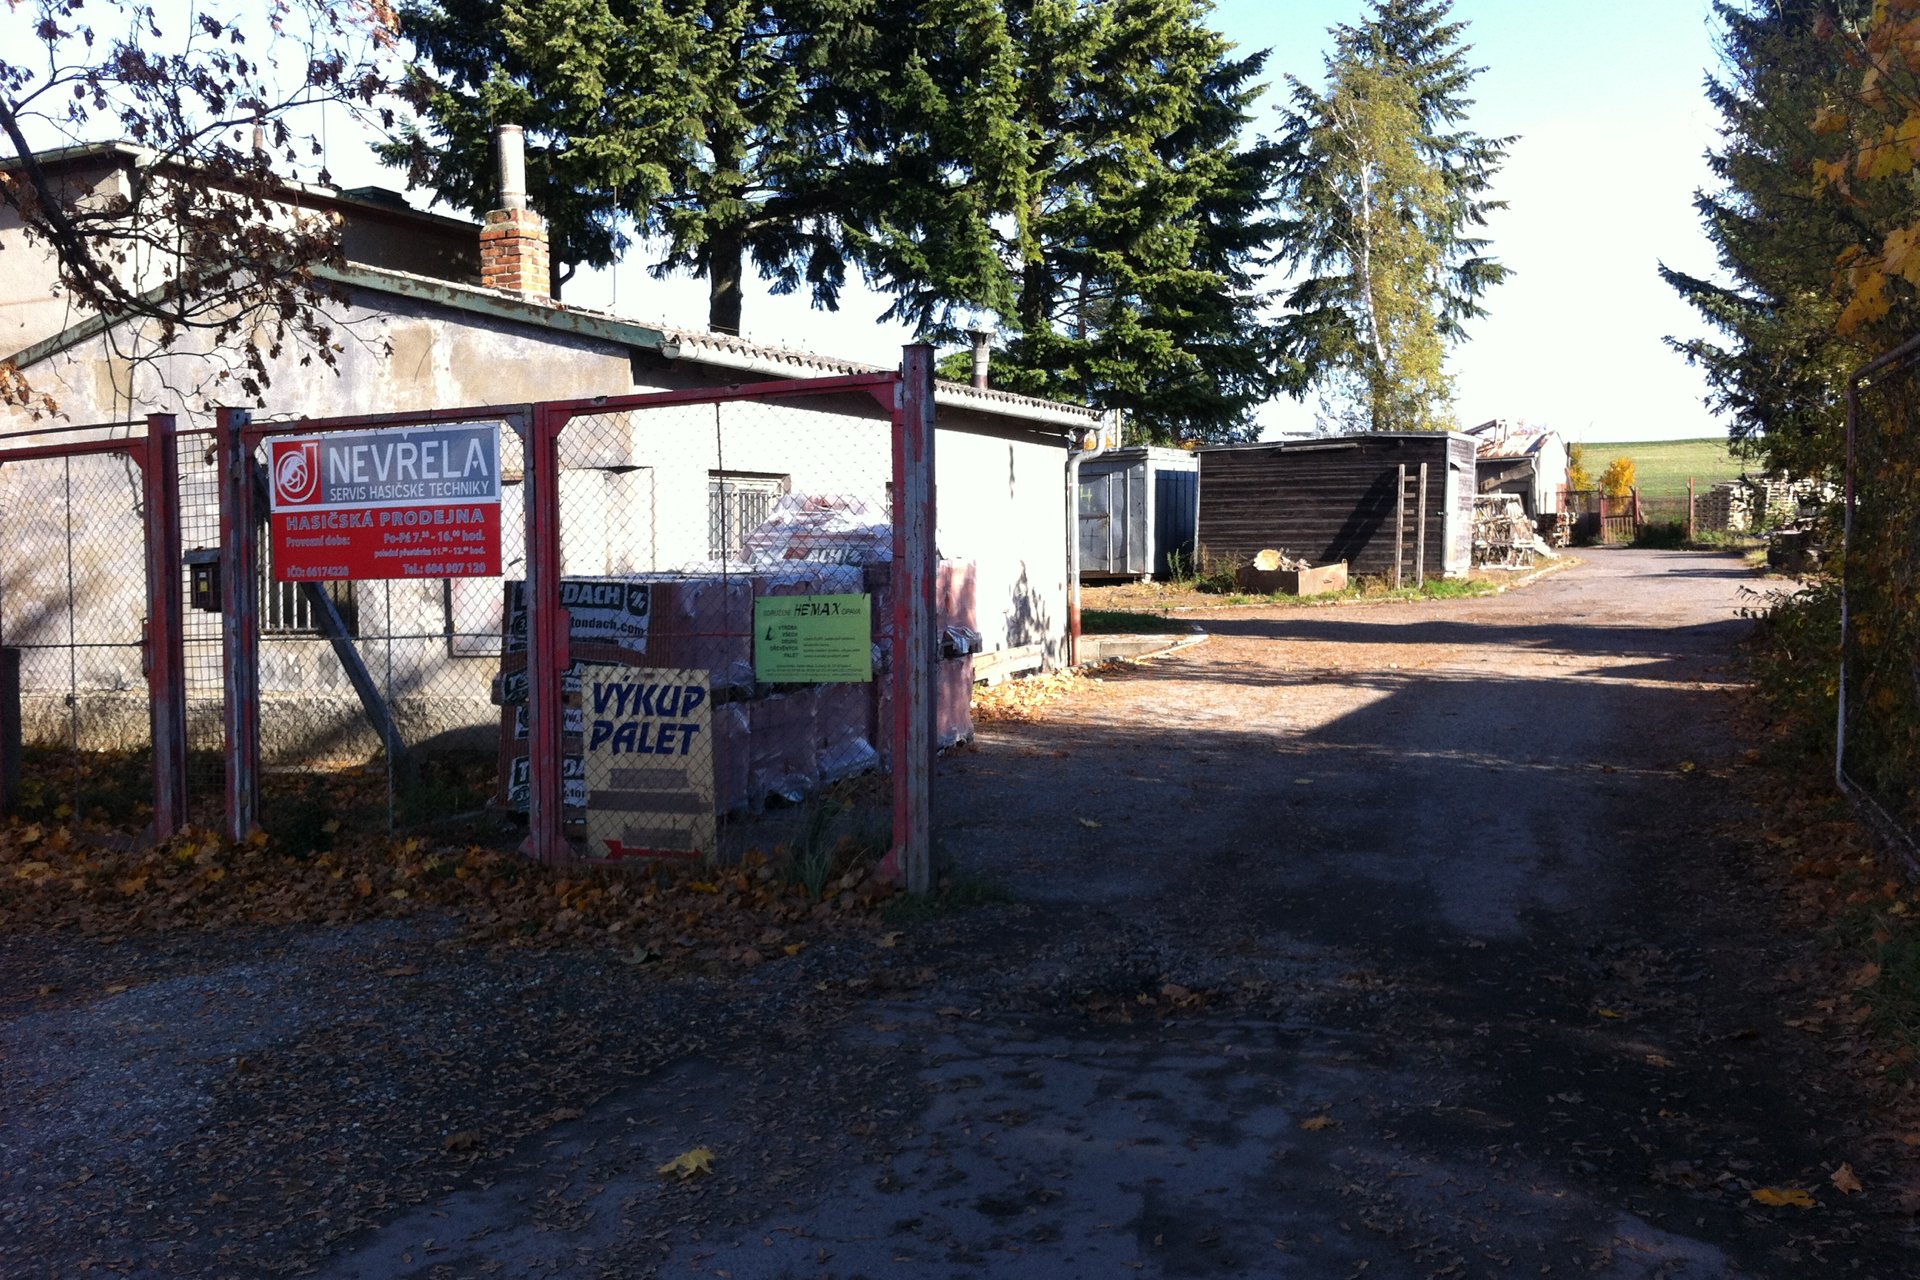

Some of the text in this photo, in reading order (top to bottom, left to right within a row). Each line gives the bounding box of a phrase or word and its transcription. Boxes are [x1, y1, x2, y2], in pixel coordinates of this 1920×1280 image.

[329, 434, 489, 485] NEVŘELA
[330, 480, 490, 502] SERVIS HASIČSKÉ TECHNIKY
[286, 508, 485, 531] HASIČSKÁ PRODEJNA
[462, 529, 486, 541] hod.
[794, 602, 842, 617] HEMAX
[593, 675, 706, 718] VÝKUP
[589, 720, 700, 756] PALET
